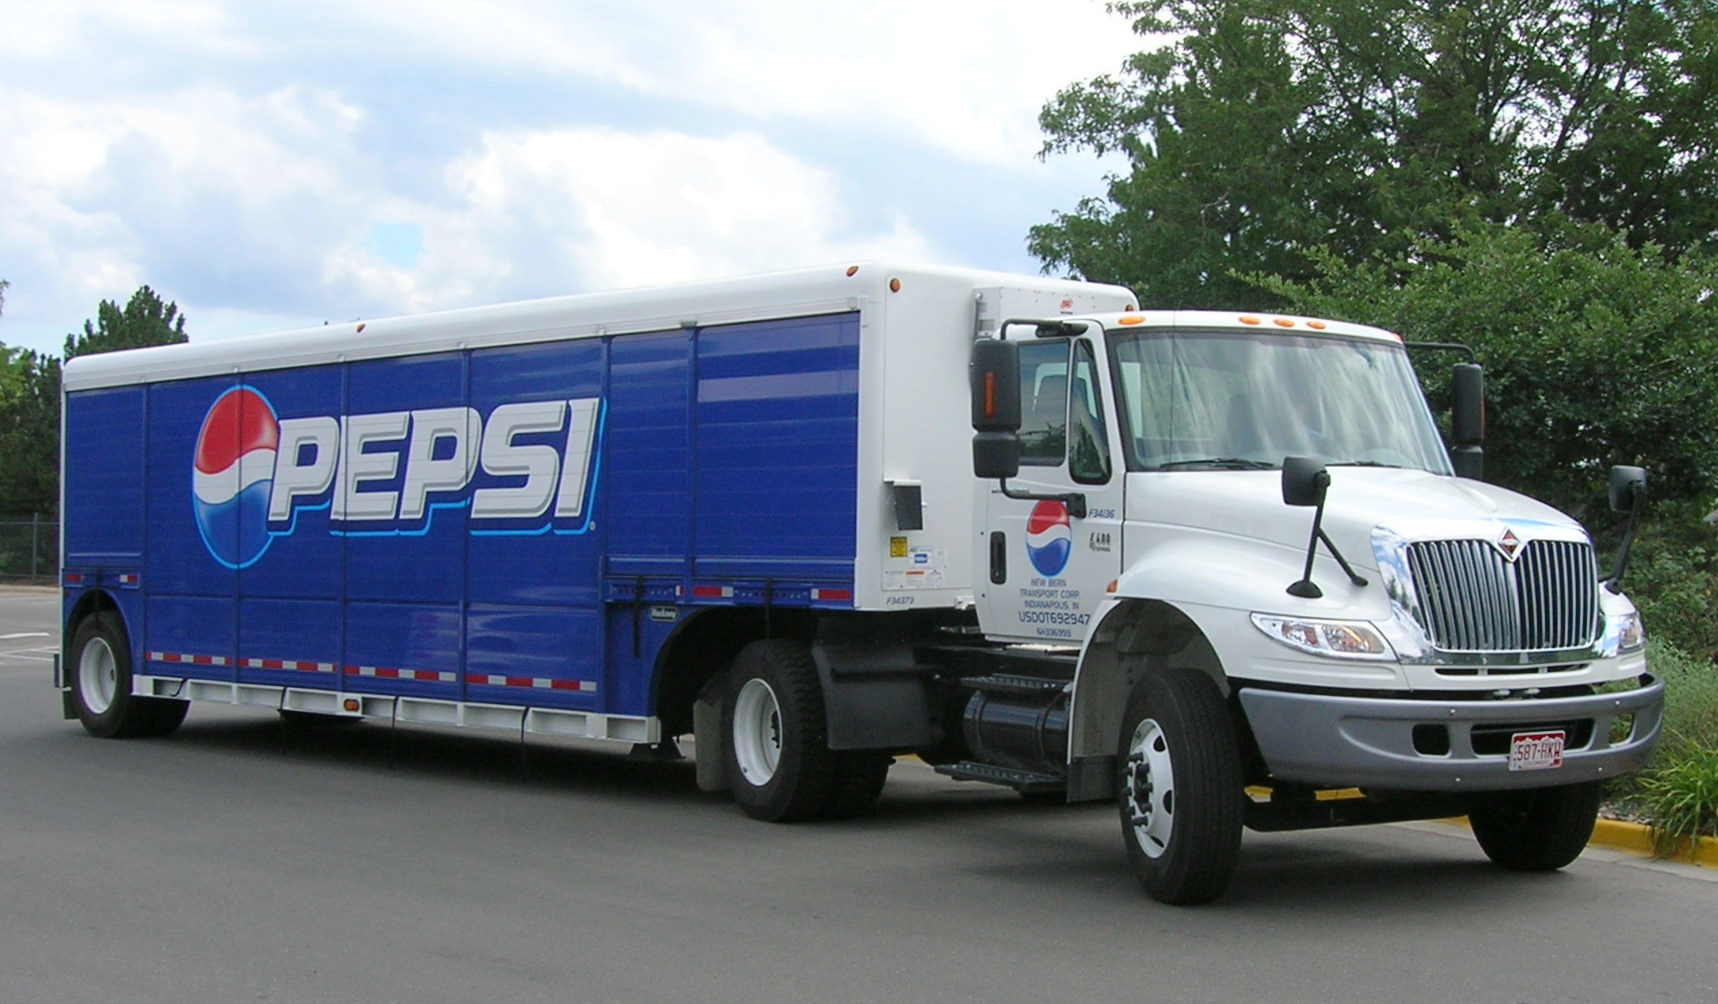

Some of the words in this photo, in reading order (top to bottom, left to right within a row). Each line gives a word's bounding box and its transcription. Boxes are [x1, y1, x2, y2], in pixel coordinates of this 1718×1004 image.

[268, 397, 600, 521] PEPSI
[1031, 578, 1045, 586] NEW
[1048, 579, 1067, 587] BERN
[1020, 588, 1058, 598] TRANSPORT
[1072, 601, 1079, 609] IN
[1018, 611, 1091, 625] USDOT692947
